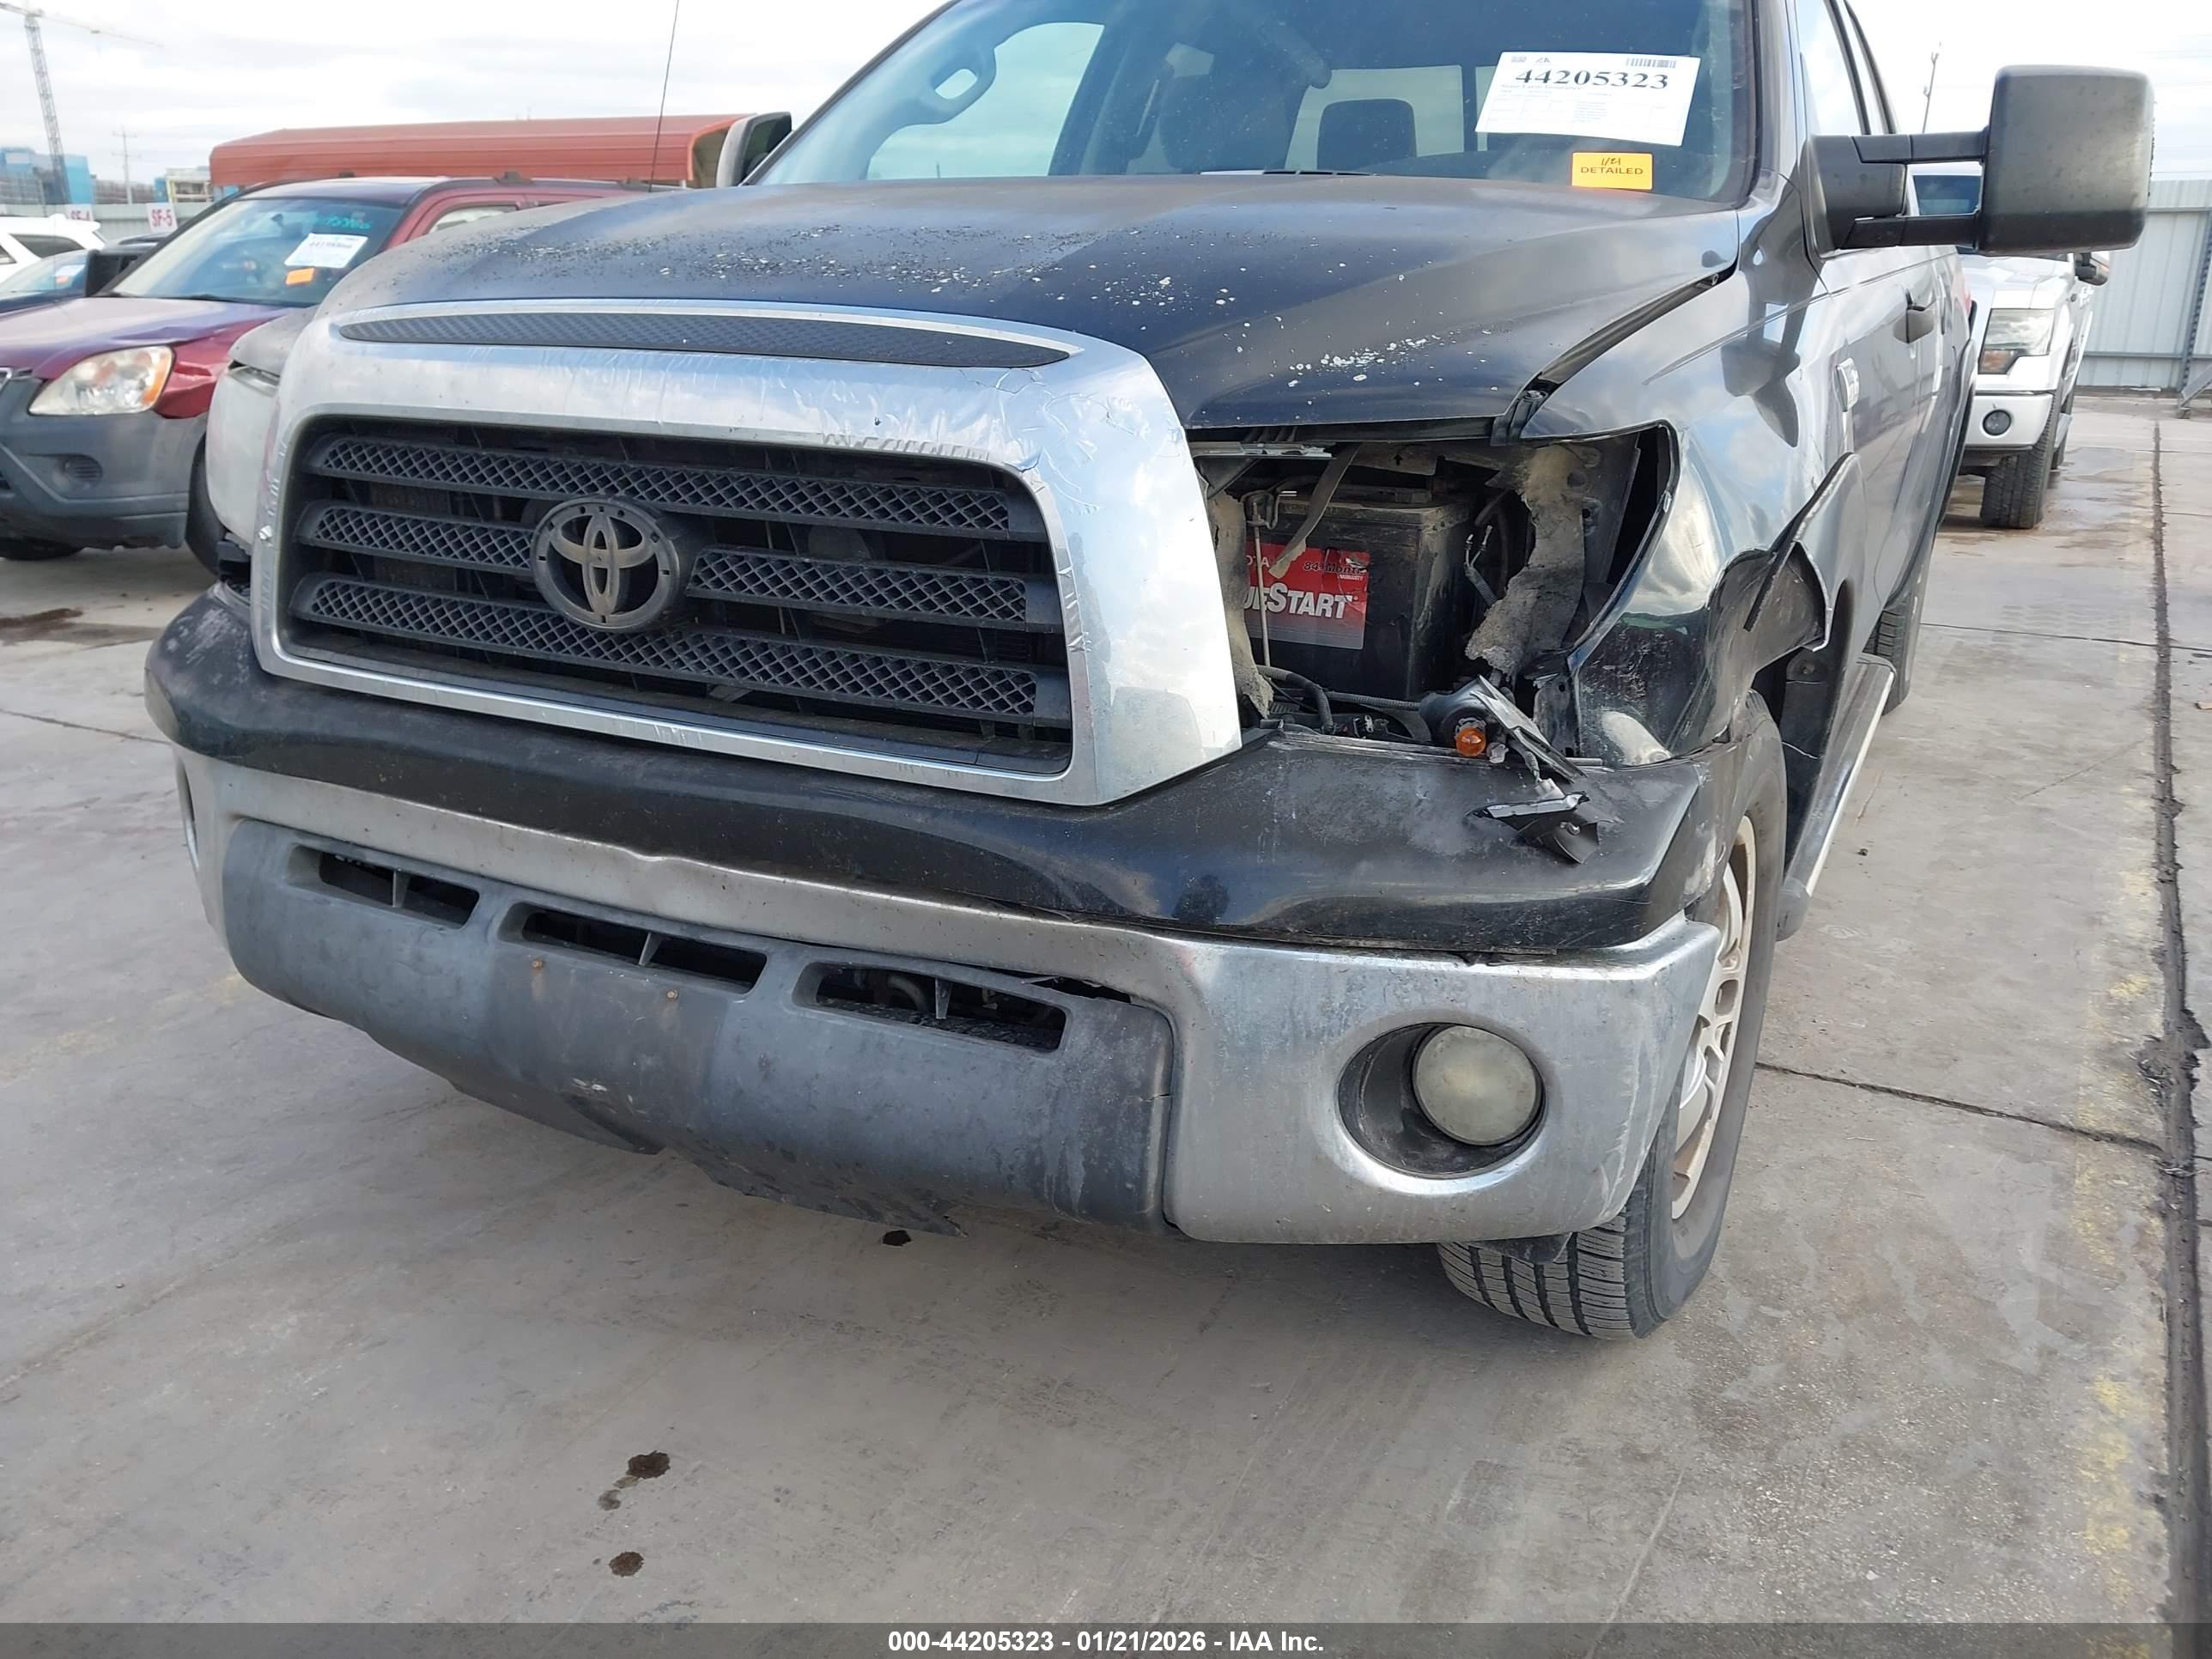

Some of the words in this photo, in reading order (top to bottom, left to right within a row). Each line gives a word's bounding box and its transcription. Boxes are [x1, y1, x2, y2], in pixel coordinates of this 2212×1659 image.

[1516, 69, 1668, 89] 44205323
[1581, 167, 1644, 175] DETAILED
[151, 209, 173, 227] SF-5
